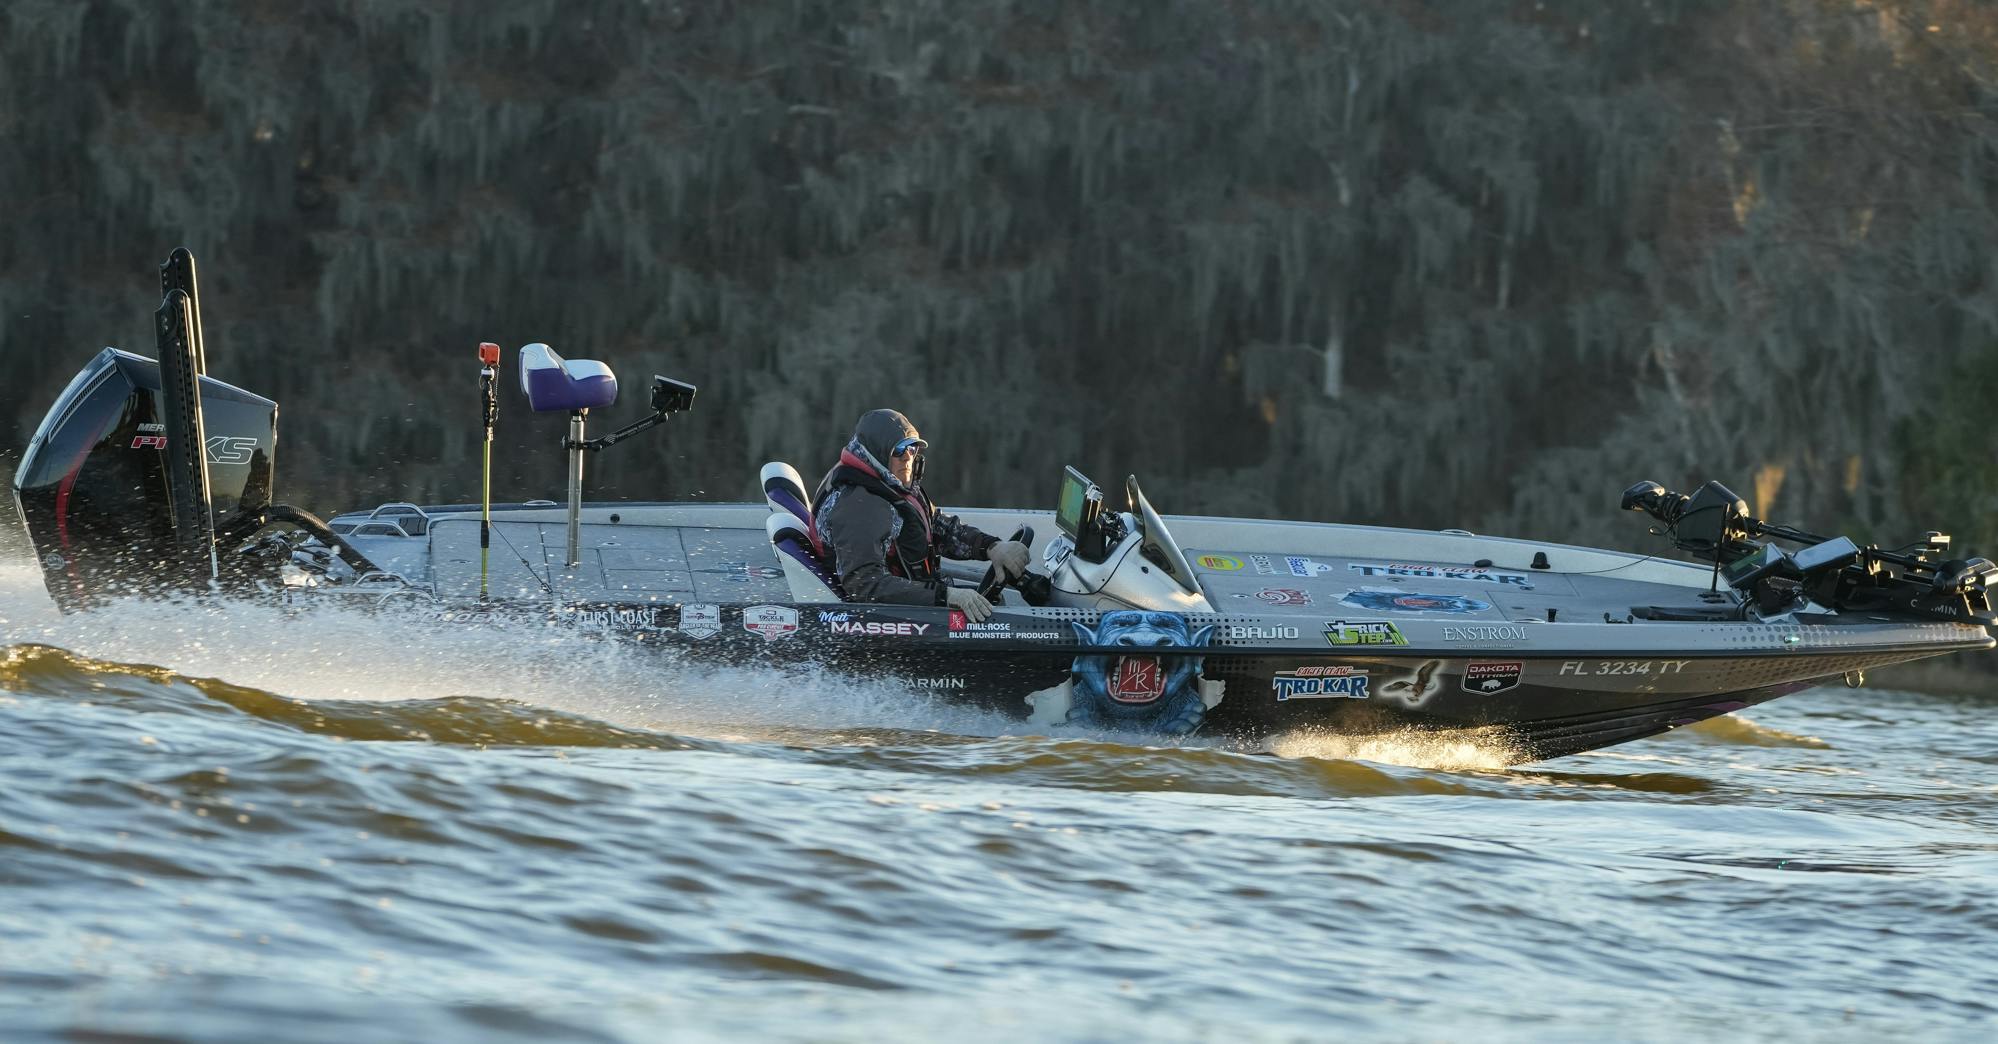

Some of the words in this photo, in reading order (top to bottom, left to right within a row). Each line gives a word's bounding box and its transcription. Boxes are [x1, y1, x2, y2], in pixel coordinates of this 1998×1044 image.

[137, 423, 166, 432] MER
[583, 610, 618, 625] FIRST
[620, 610, 658, 625] COAST
[818, 611, 851, 622] Matt
[830, 621, 930, 635] MASSEY
[966, 622, 1011, 631] MILL-ROSE
[1443, 626, 1528, 641] ENSTROM
[1469, 665, 1519, 673] DAKOTA
[1559, 661, 1588, 675] FL
[1595, 661, 1652, 675] 3234
[1660, 660, 1691, 674] TY
